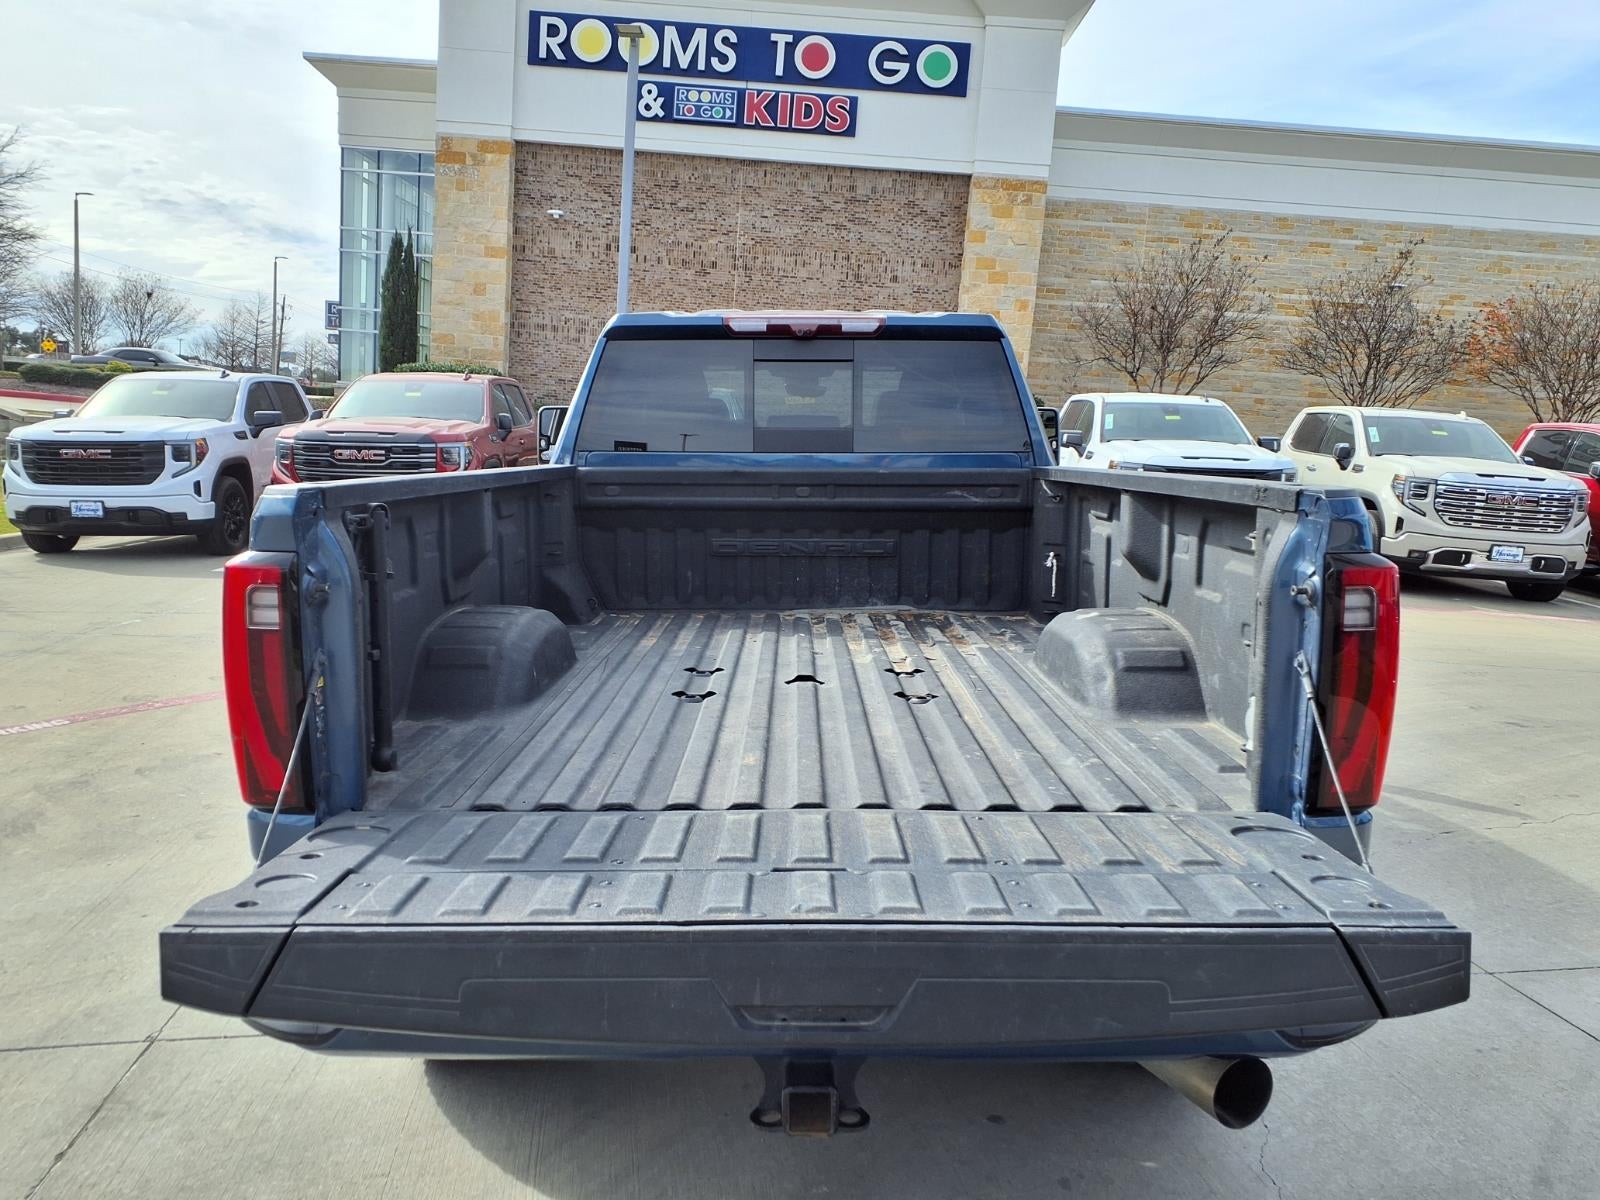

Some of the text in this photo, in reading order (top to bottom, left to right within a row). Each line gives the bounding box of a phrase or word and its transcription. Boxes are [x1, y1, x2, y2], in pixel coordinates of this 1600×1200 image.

[538, 15, 958, 88] ROOMS TO GO
[638, 83, 665, 118] &
[678, 89, 732, 105] ROOMS
[678, 103, 723, 119] TO GO
[744, 90, 850, 133] KIDS
[60, 449, 111, 459] GMC
[333, 449, 386, 460] GMC
[1487, 494, 1539, 506] GMC
[711, 541, 897, 556] DENALI
